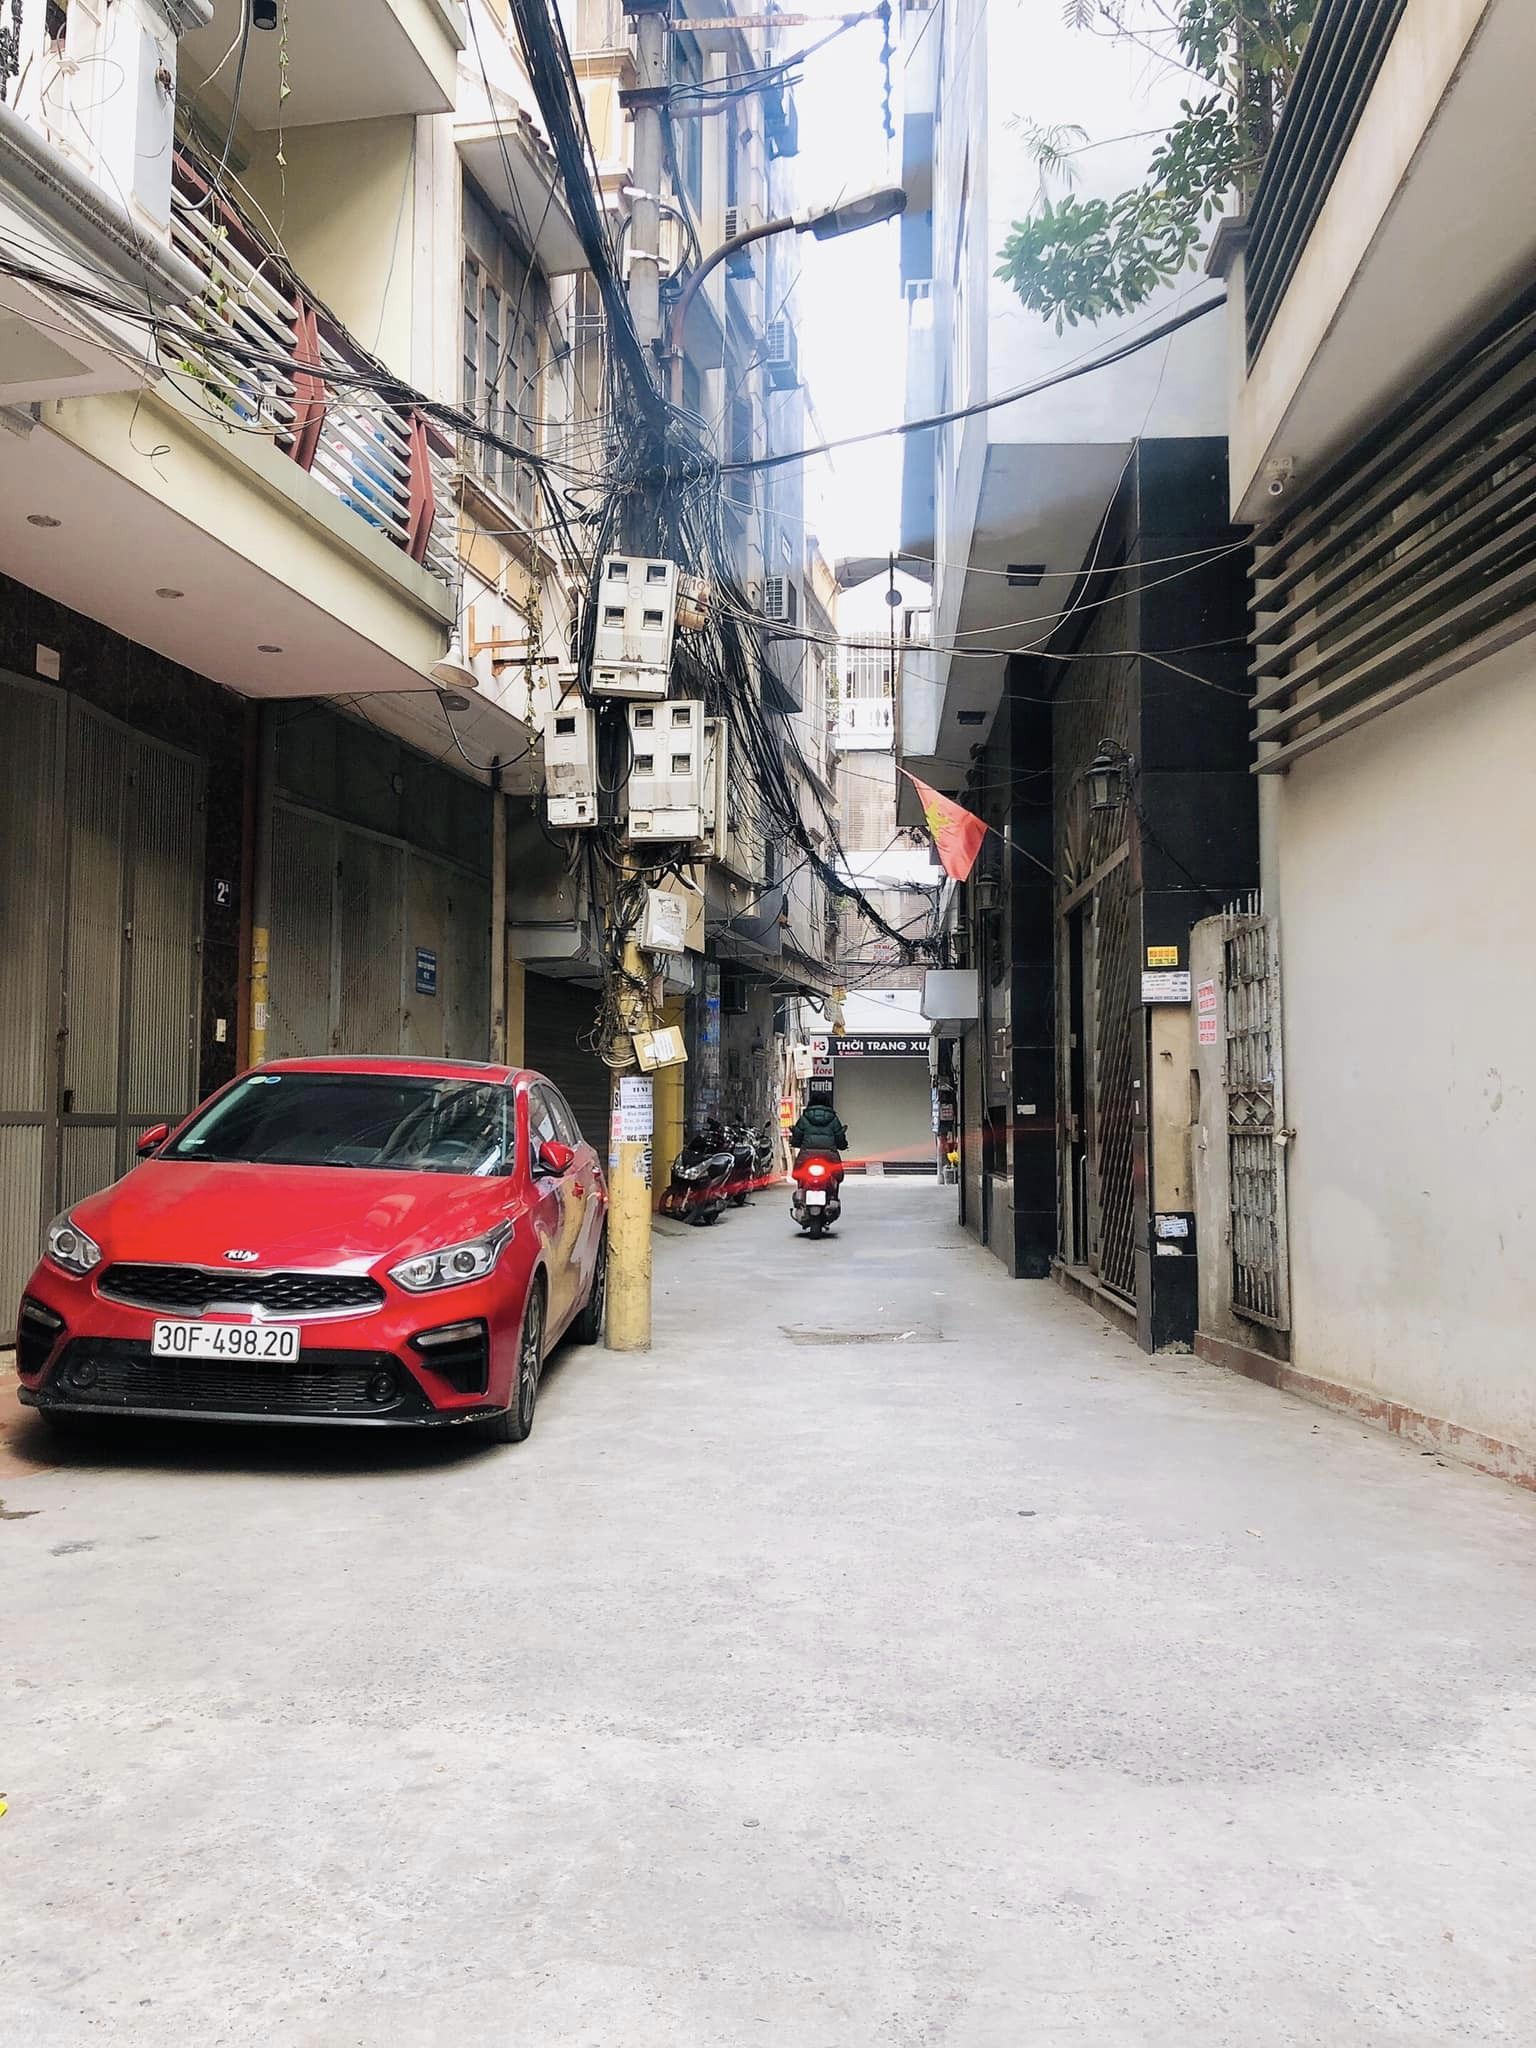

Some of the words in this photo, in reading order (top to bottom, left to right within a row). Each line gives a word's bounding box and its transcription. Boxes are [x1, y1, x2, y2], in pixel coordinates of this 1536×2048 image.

[836, 1039, 864, 1050] THỜI
[867, 1041, 907, 1050] TRANG
[158, 1325, 294, 1357] 30F-498.20
